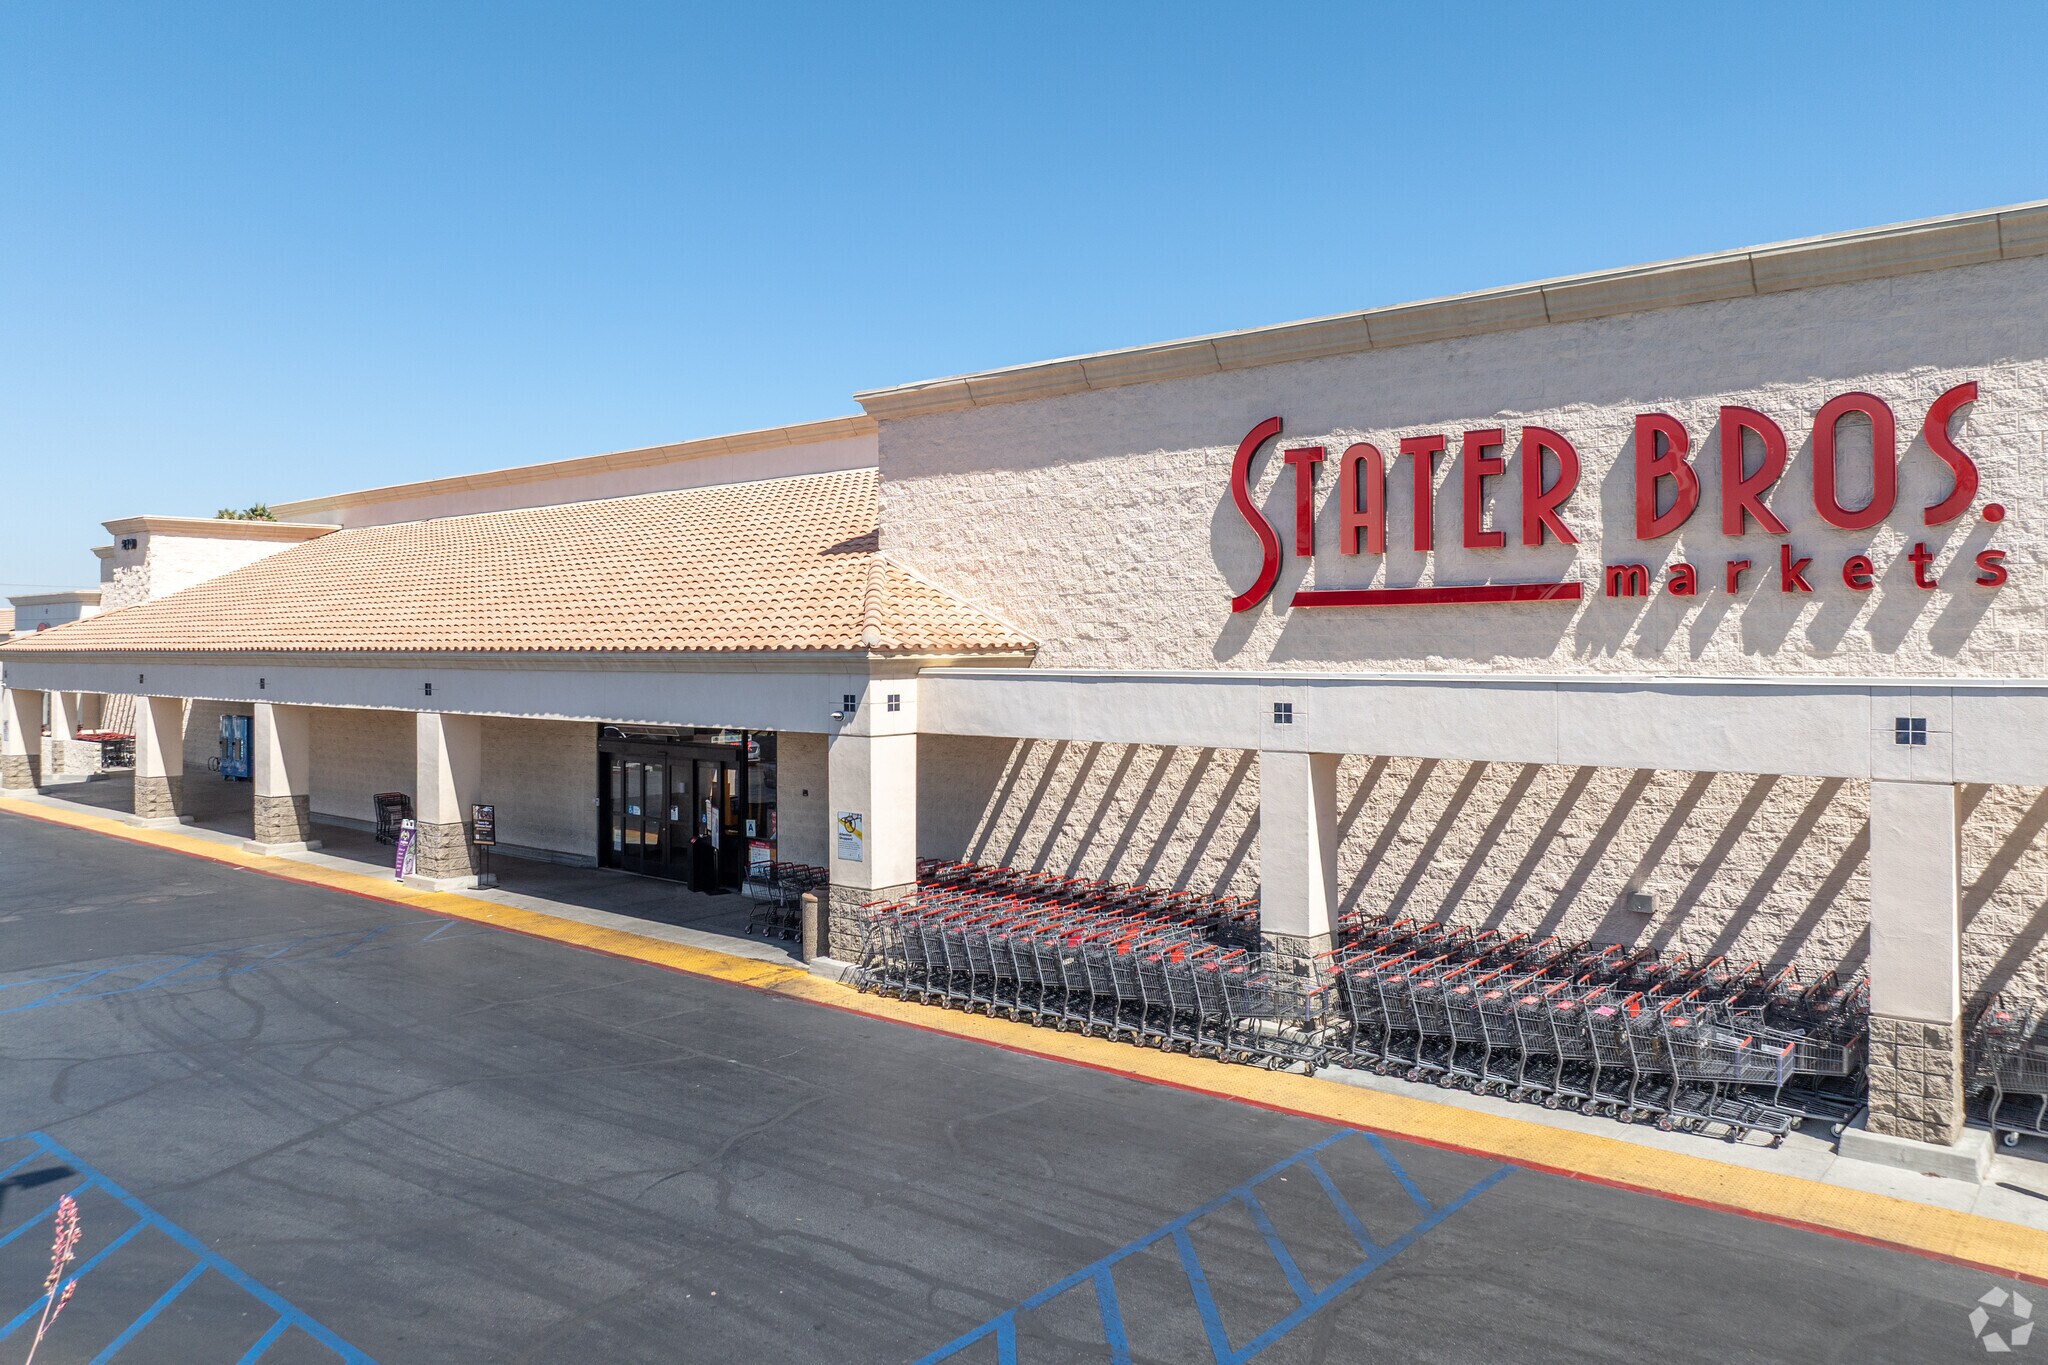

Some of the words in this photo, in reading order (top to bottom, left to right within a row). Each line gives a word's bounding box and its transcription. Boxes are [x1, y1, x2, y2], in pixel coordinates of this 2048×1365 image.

[1230, 415, 1582, 614] STATER
[1634, 381, 2006, 541] BROS.
[1604, 543, 2008, 598] markets
